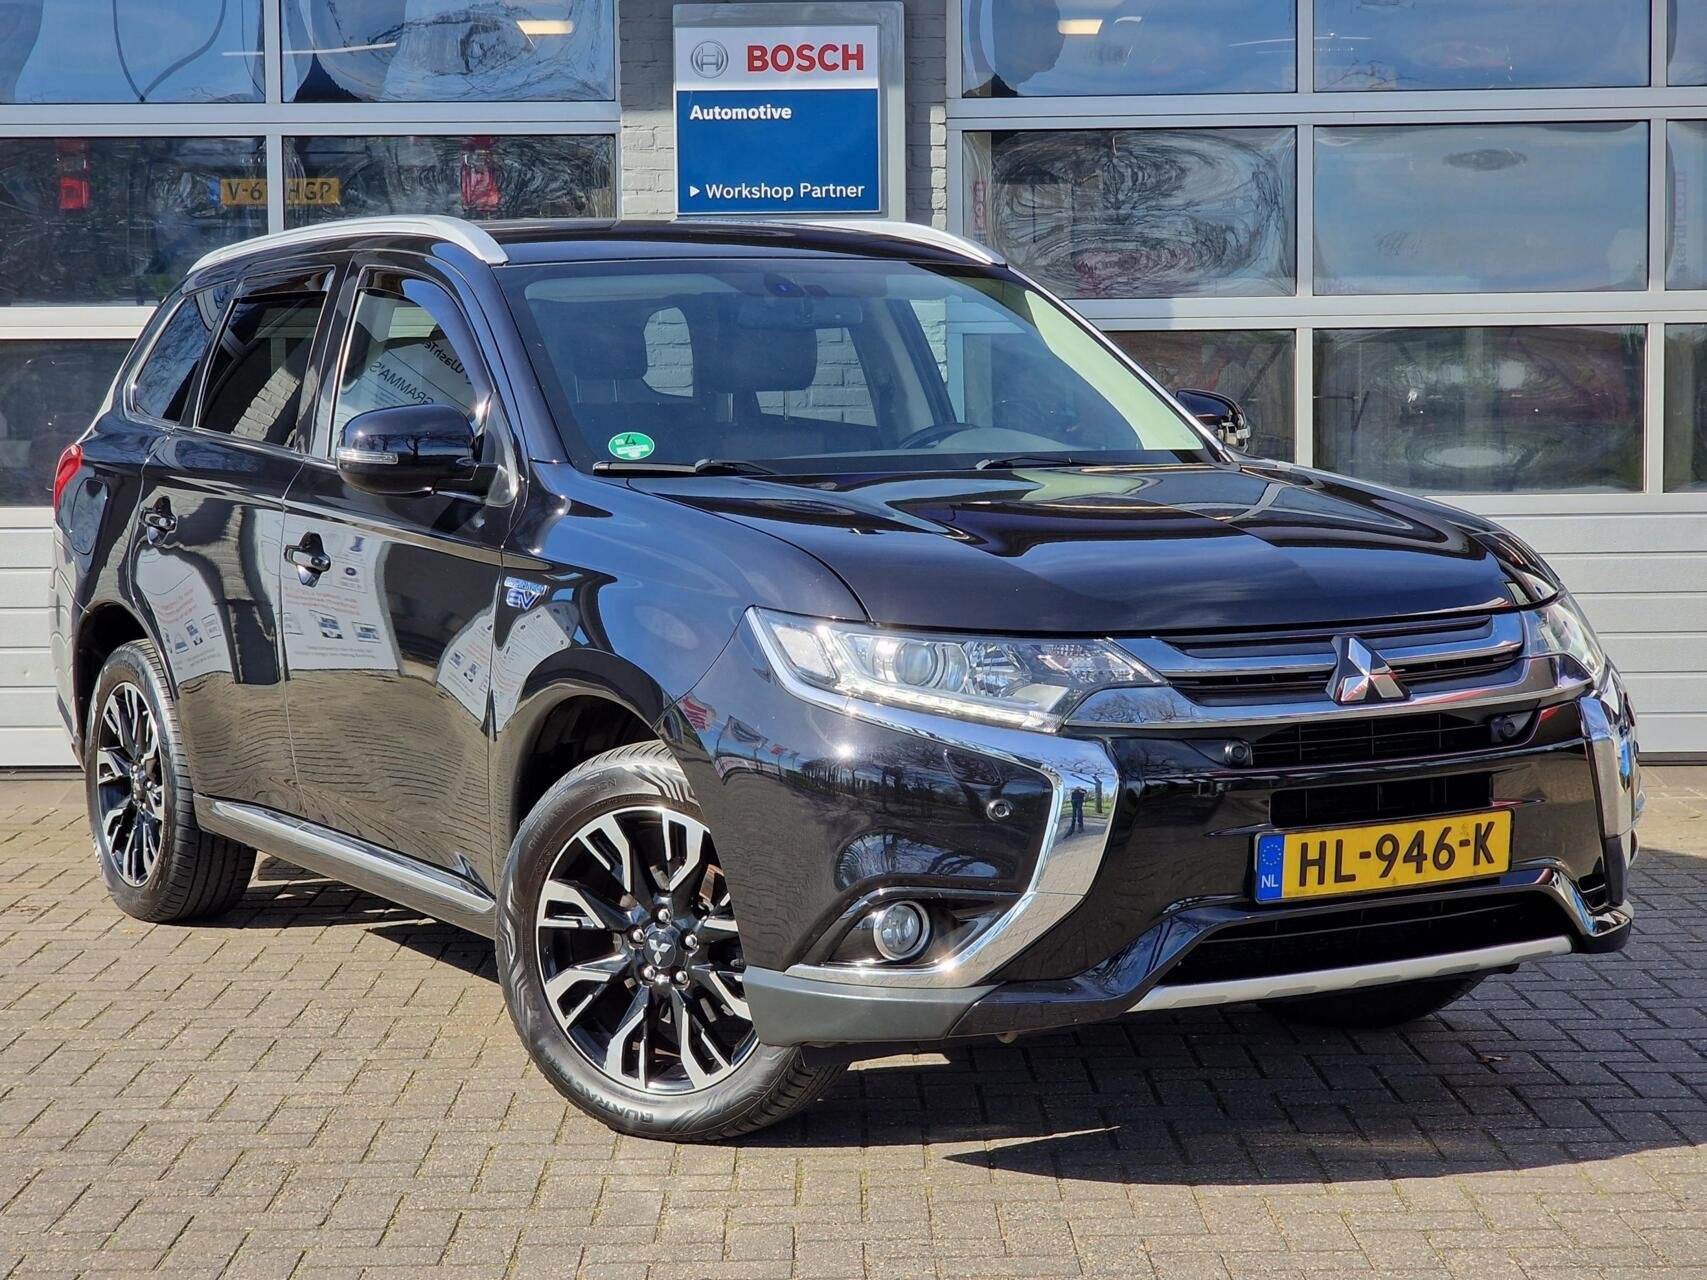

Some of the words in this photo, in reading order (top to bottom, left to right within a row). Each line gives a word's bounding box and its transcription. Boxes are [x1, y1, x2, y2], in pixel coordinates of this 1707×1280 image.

[747, 43, 865, 73] BOSCH
[689, 104, 793, 121] Automotive
[705, 183, 794, 201] Workshop
[799, 182, 866, 199] Partner
[624, 433, 637, 446] 4
[506, 587, 541, 610] EV
[1298, 821, 1496, 888] HL-946-K
[1260, 875, 1280, 889] NL
